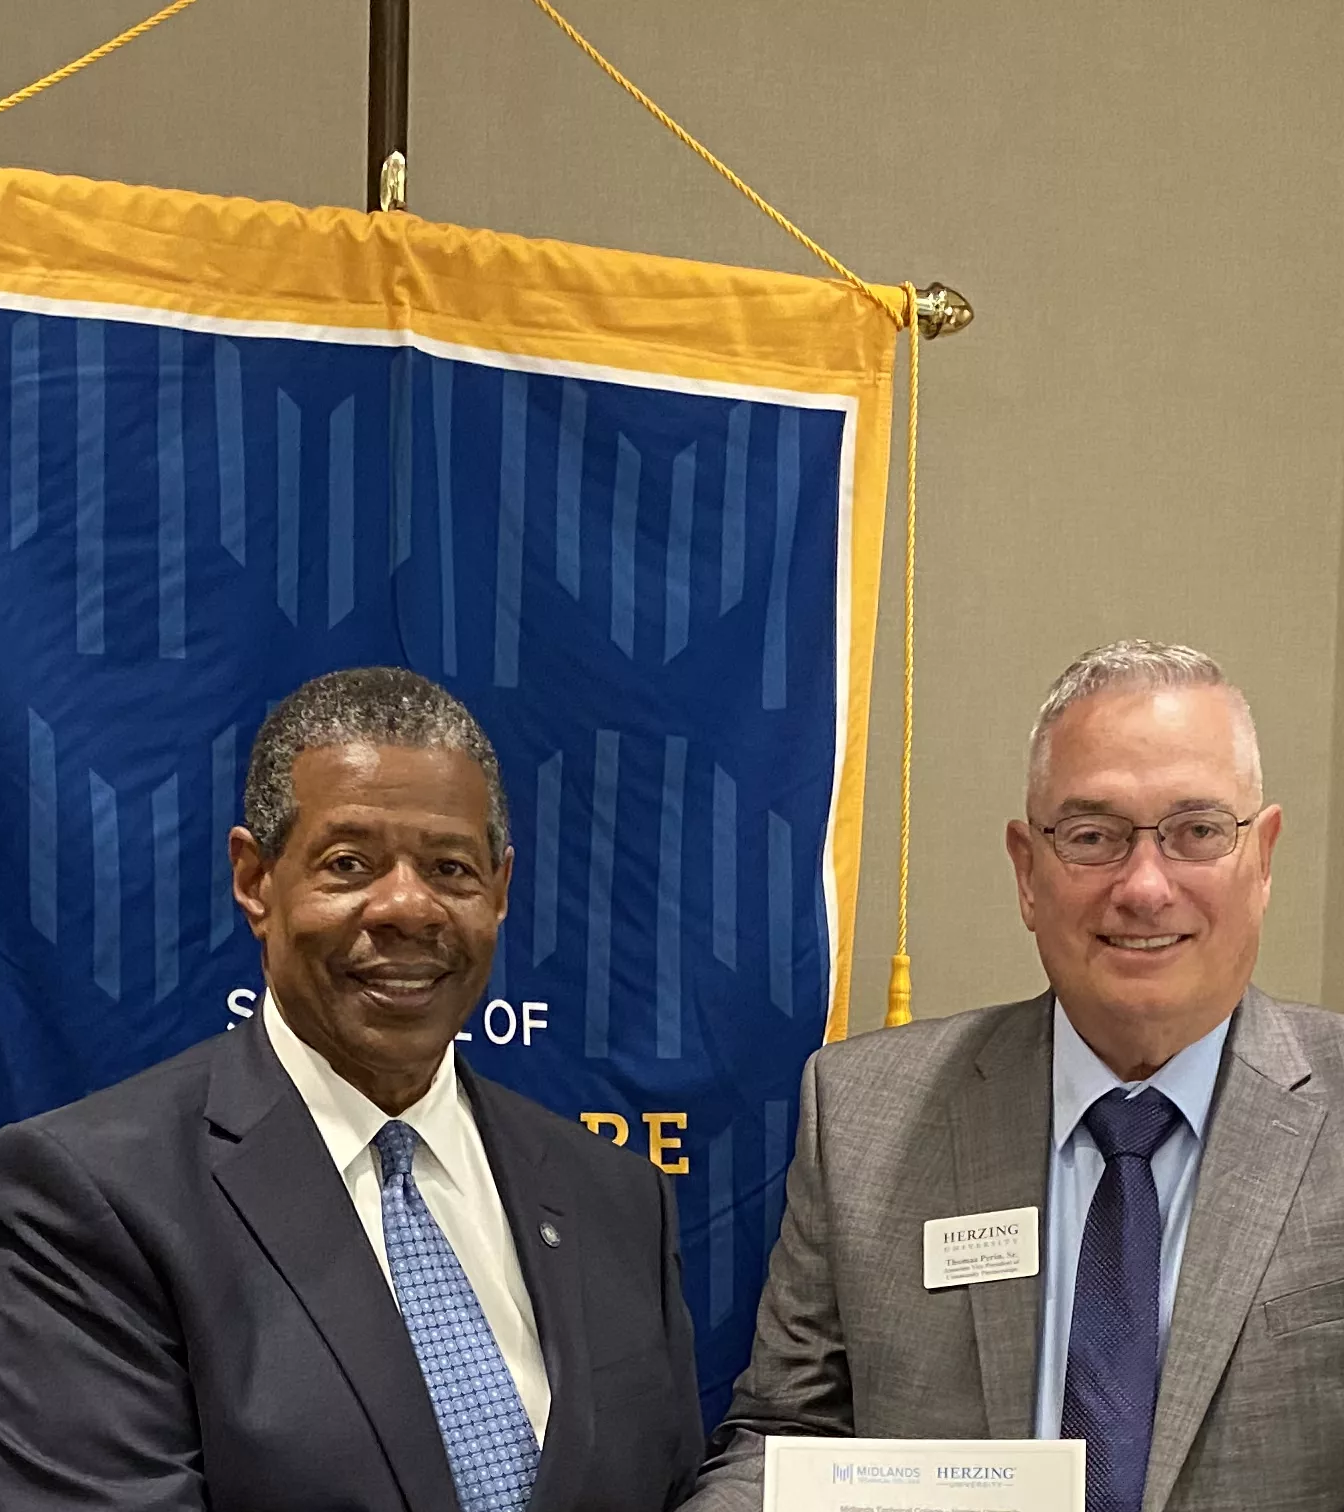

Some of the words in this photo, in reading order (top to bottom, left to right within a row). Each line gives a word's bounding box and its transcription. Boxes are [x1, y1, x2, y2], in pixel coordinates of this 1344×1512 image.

[484, 998, 548, 1046] OF
[944, 1224, 1019, 1244] HERZING
[856, 1466, 921, 1478] MIDLANDS
[936, 1467, 1015, 1480] HERZING
